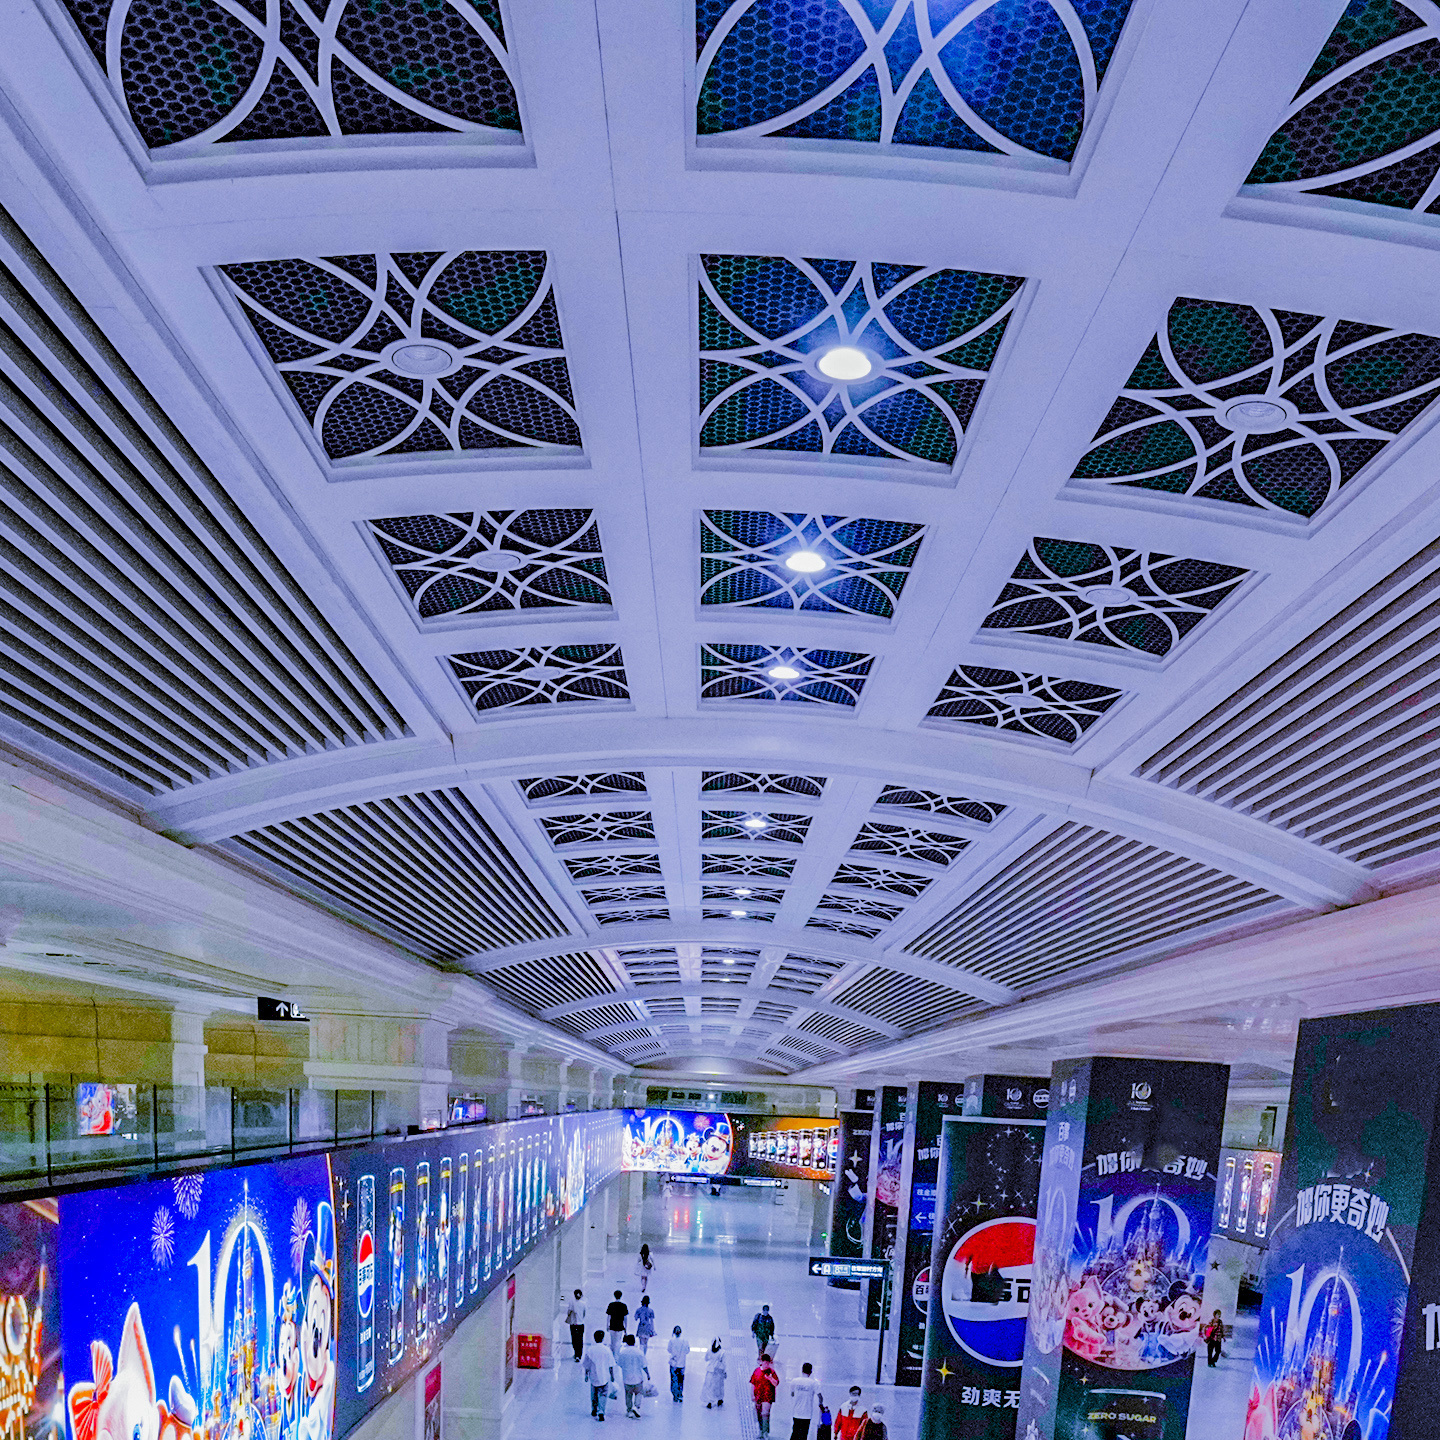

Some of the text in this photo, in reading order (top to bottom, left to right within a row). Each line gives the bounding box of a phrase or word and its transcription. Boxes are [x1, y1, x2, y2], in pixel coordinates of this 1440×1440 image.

[641, 1116, 684, 1144] 10
[1096, 1150, 1209, 1181] 加你奇妙
[1089, 1194, 1191, 1251] 10
[1296, 1183, 1390, 1244] 加你更奇妙
[1087, 1412, 1157, 1425] ZERO SUGAR
